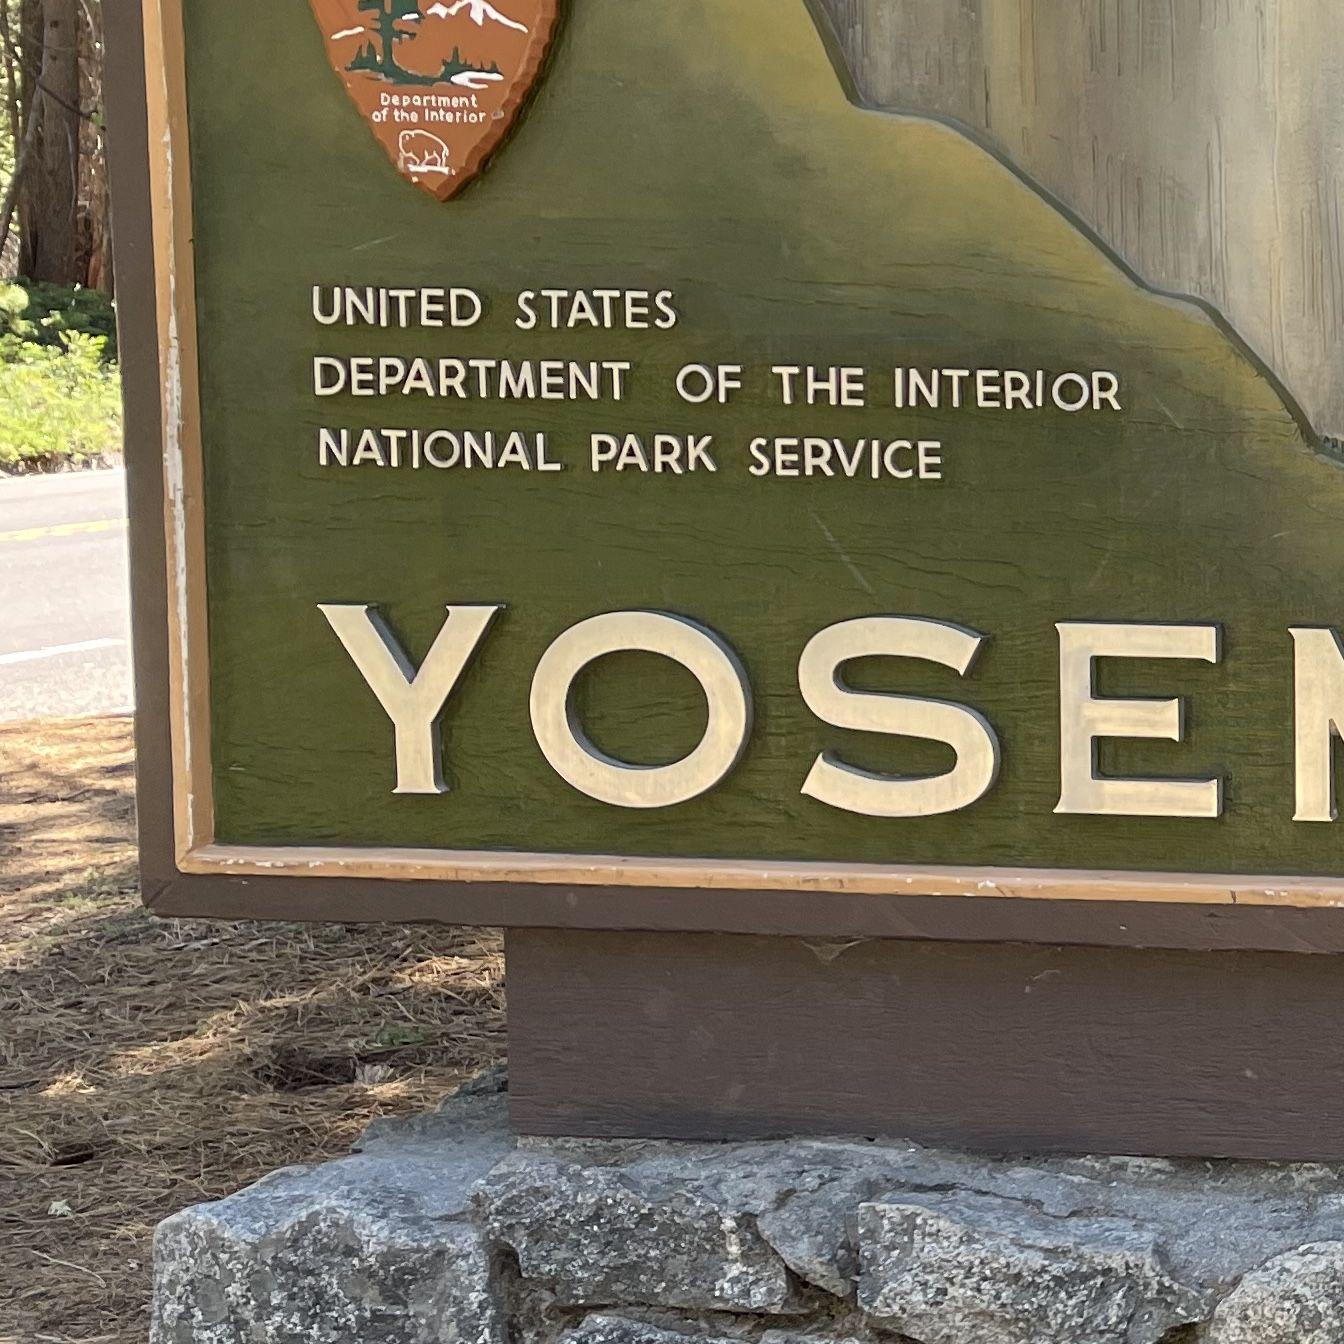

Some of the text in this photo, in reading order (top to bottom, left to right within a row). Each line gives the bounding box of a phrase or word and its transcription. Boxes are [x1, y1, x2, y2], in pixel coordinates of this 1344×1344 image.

[371, 109, 487, 124] of the Interior
[379, 92, 478, 109] Department
[312, 285, 676, 330] UNITED STATES
[313, 356, 1122, 412] DEPARTMENT OF THE INTERIOR
[318, 427, 942, 480] NATIONAL PARK SERVICE
